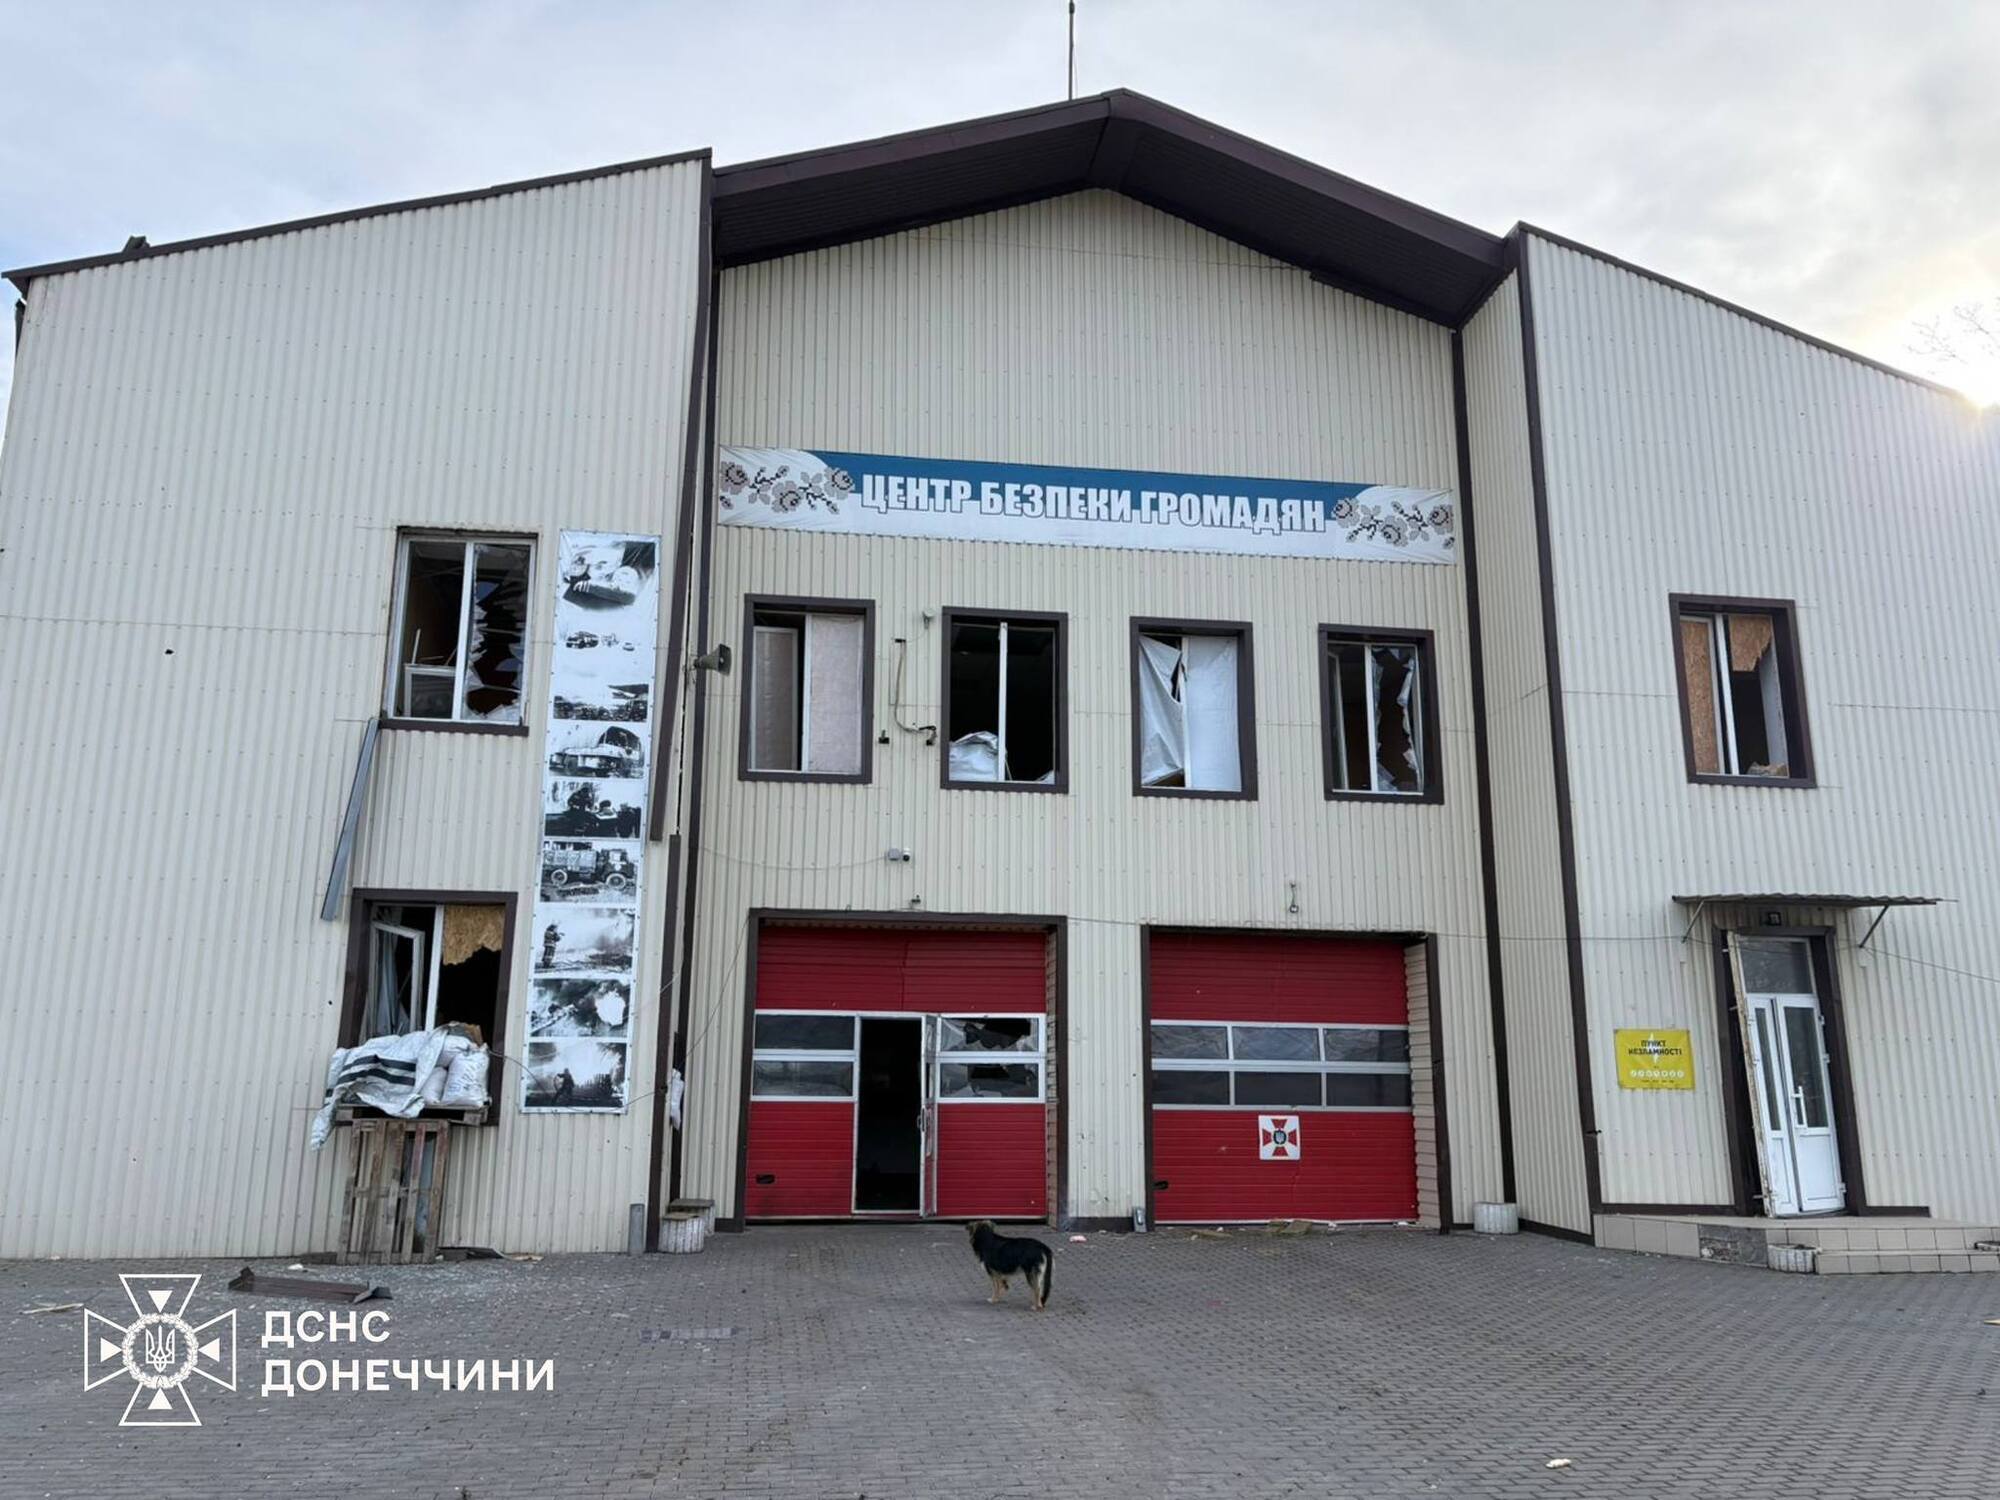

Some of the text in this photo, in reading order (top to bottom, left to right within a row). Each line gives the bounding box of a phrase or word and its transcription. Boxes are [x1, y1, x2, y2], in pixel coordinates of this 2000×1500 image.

[861, 473, 1326, 536] ЦЕНТР БЕЗПЕКИ ГРОМАДЯН
[1628, 1048, 1682, 1056] НЕЗЛАМНОСТІ
